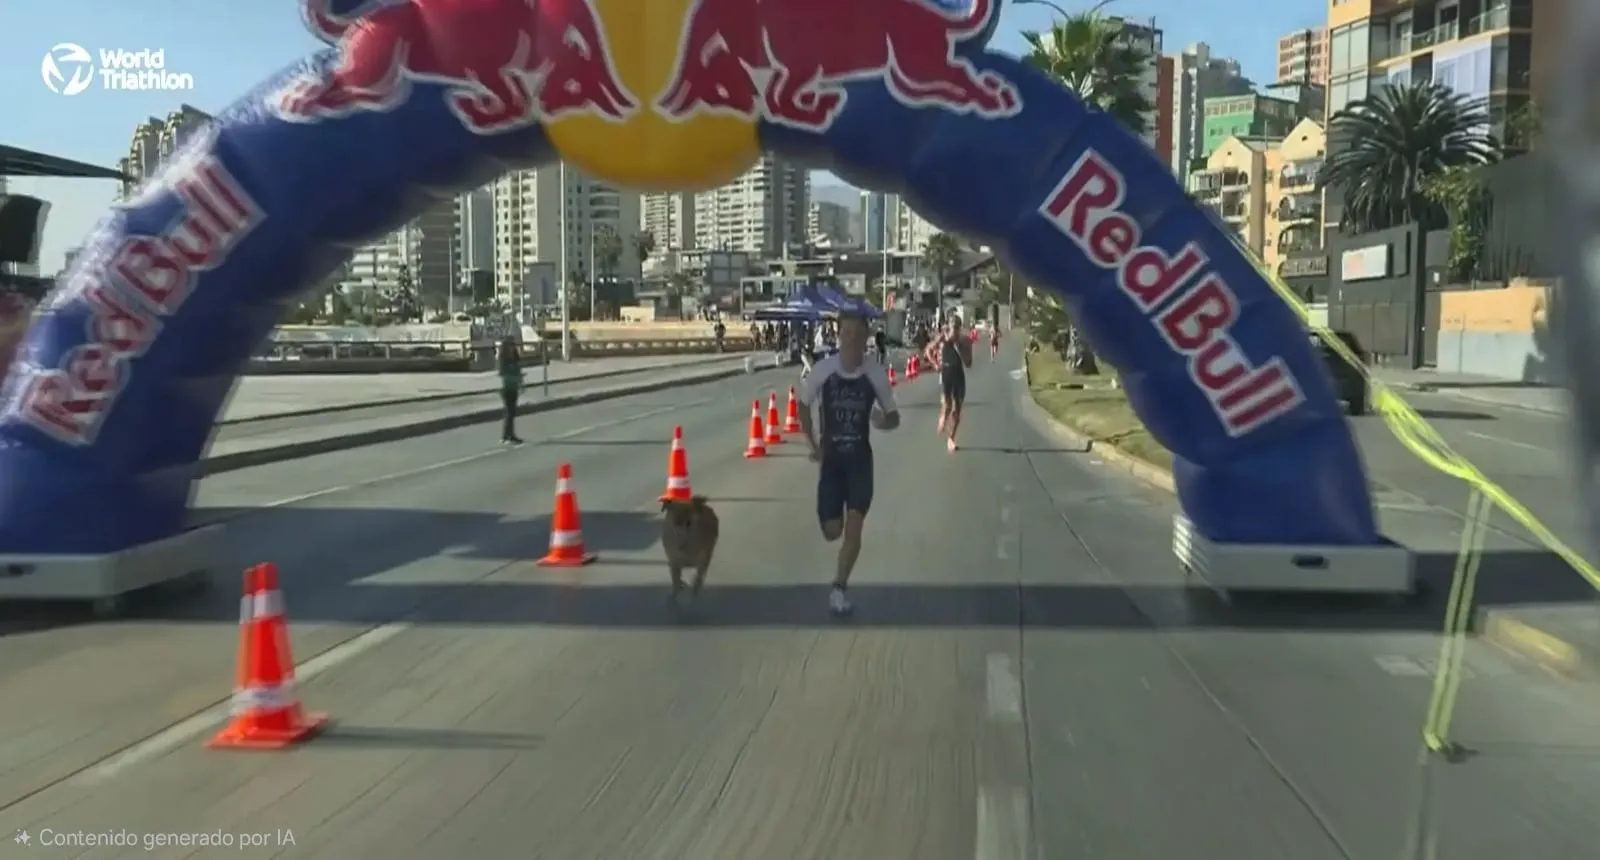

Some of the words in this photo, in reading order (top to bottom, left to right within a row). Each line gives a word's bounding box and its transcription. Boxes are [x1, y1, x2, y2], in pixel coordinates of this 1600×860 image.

[20, 283, 156, 440] Red
[109, 157, 261, 310] Bull
[1041, 152, 1207, 310] Red
[1157, 273, 1303, 433] Bull
